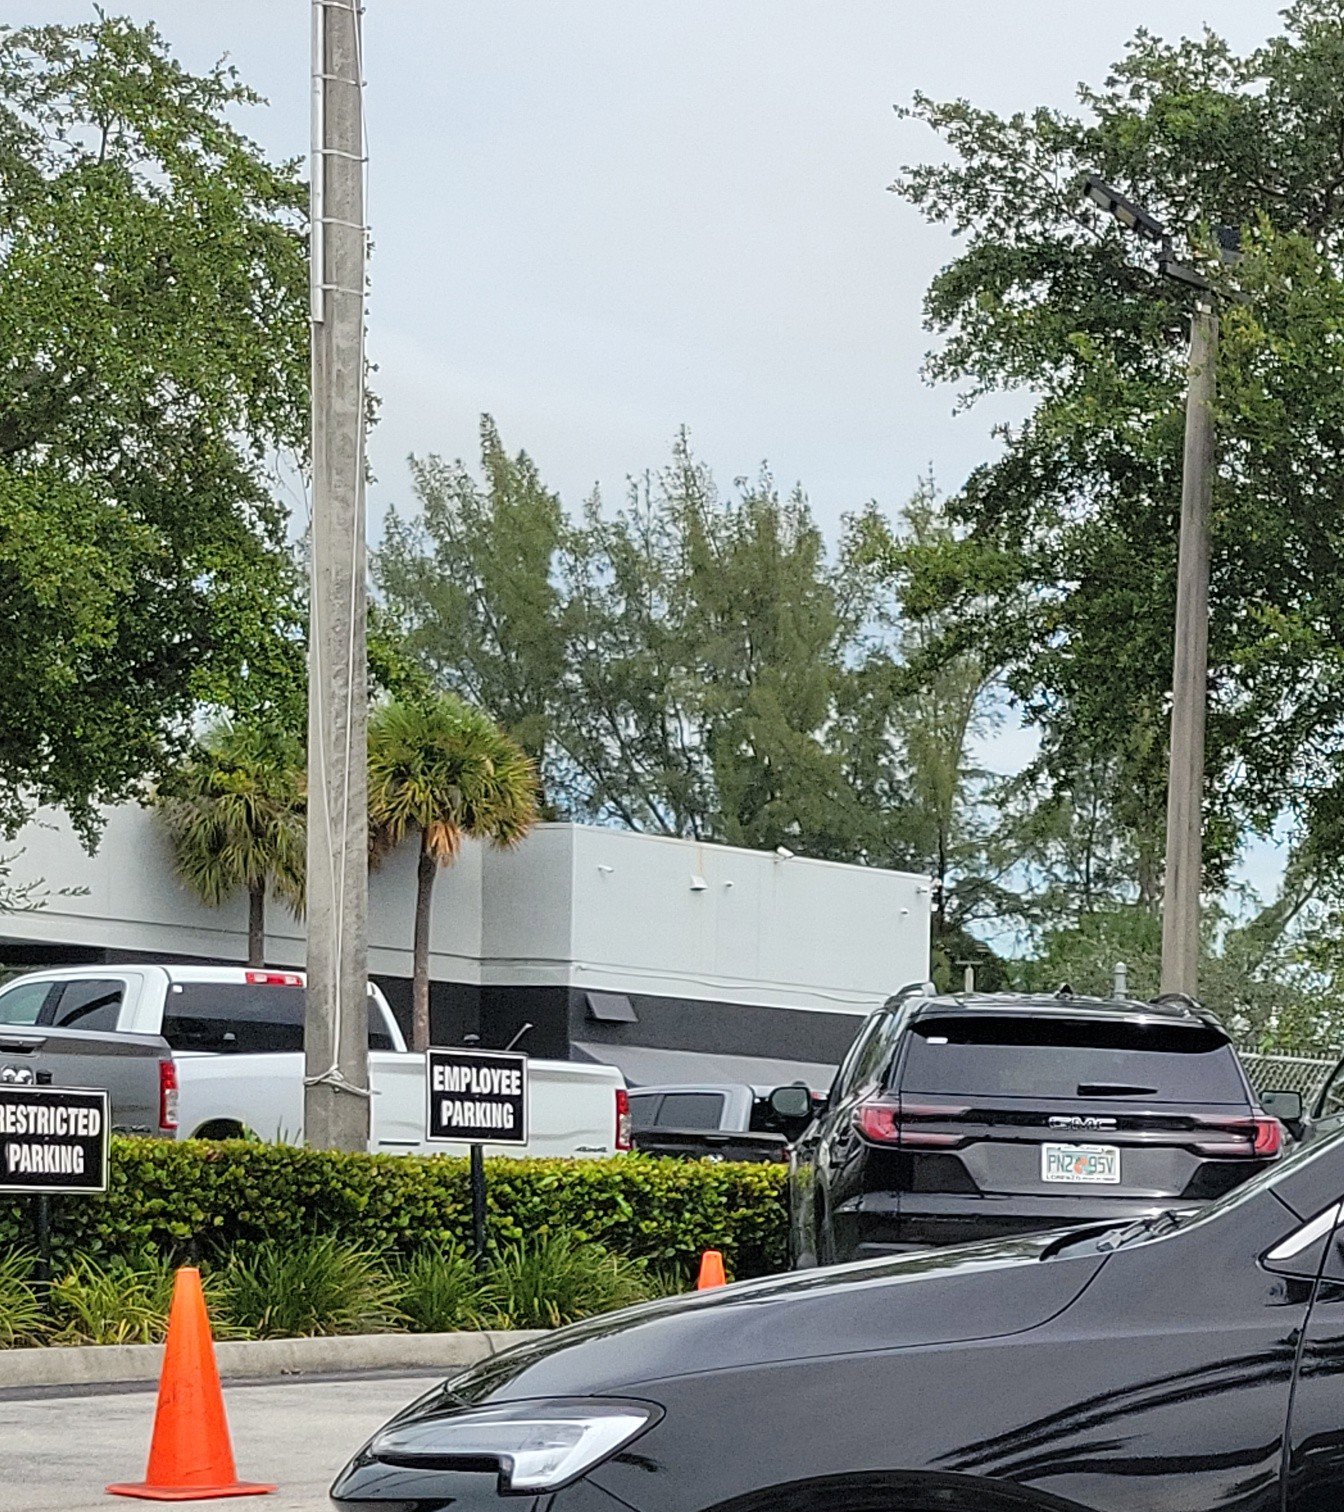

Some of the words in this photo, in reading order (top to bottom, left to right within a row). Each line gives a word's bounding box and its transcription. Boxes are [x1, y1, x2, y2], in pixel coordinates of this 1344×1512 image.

[433, 1065, 522, 1096] EMPLOYEE
[441, 1100, 514, 1129] PARKING
[1048, 1116, 1117, 1132] GMC
[8, 1143, 85, 1174] PARKING
